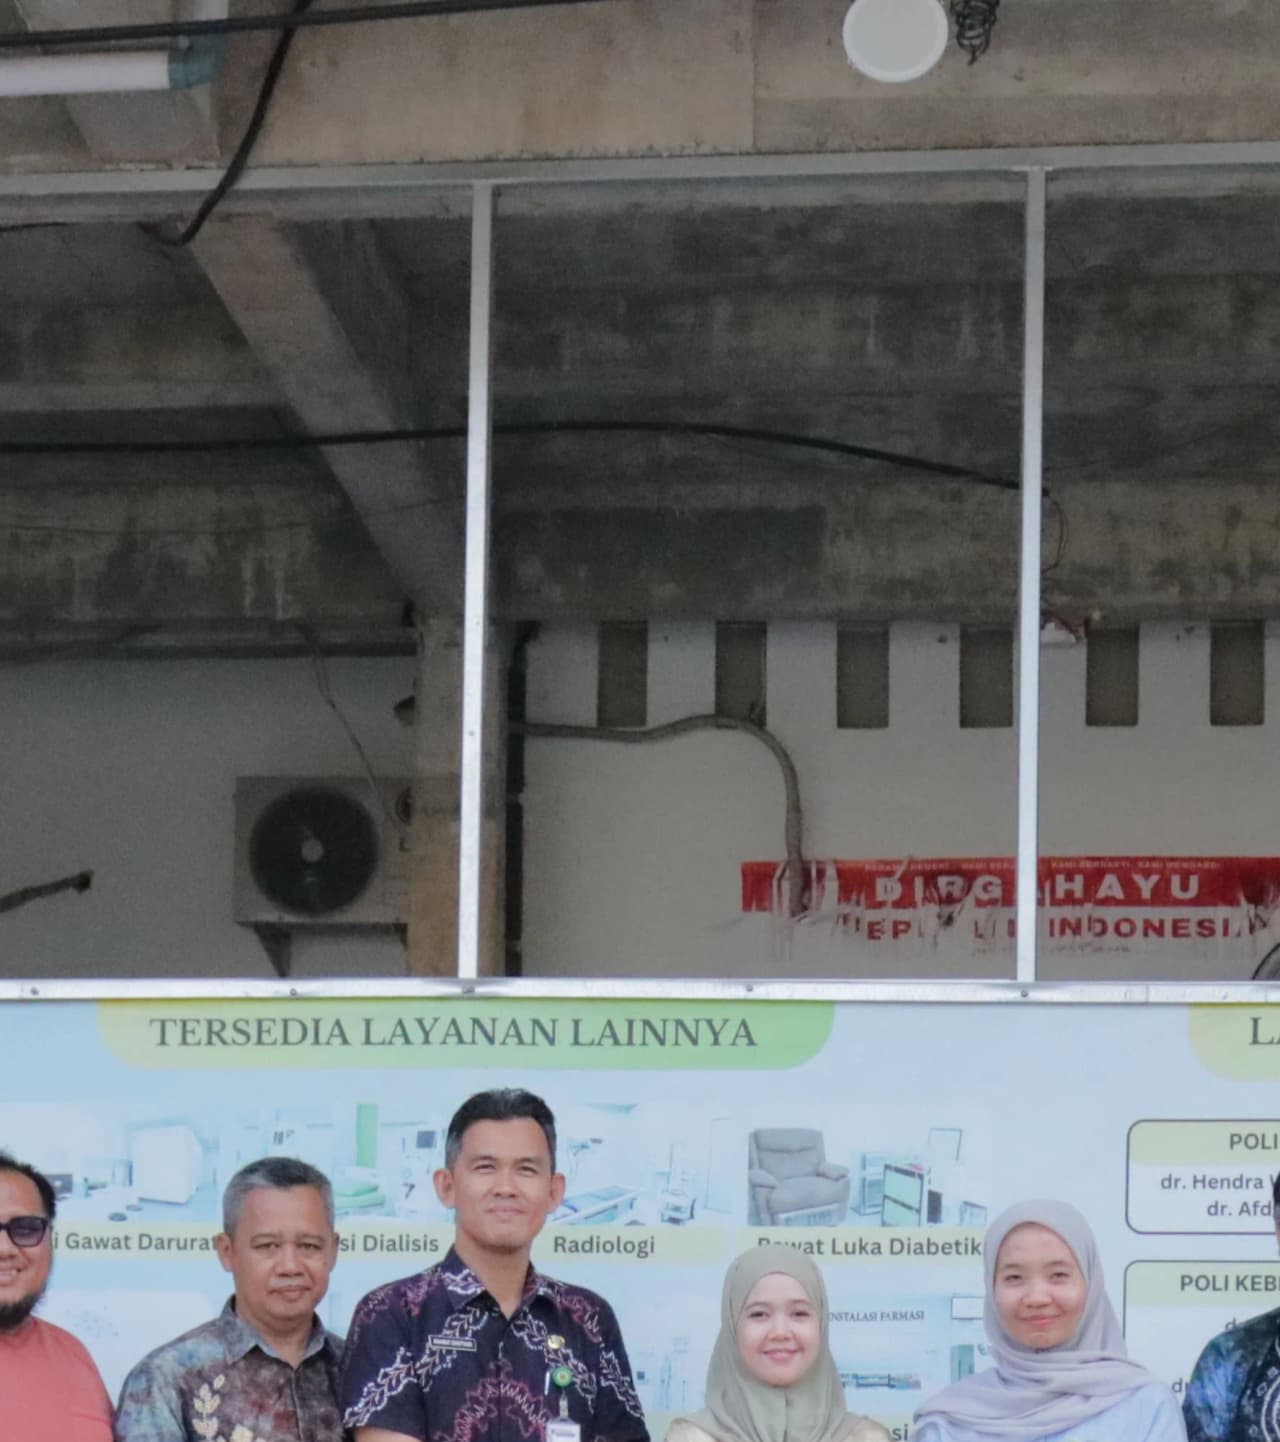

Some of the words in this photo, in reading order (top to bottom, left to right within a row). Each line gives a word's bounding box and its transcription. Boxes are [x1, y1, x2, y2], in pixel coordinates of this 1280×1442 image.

[874, 872, 1200, 901] DIRGHAYU
[150, 1017, 350, 1047] TERSEDIA
[362, 1017, 558, 1047] LAYANAN
[570, 1017, 758, 1047] LAINNYA
[1229, 1133, 1278, 1150] POLI
[1160, 1174, 1187, 1190] dr.
[1193, 1174, 1264, 1191] Hendra
[1207, 1203, 1233, 1218] dr.
[65, 1233, 132, 1250] Gawat
[363, 1234, 440, 1252] Dialisis
[553, 1235, 655, 1259] Radiologi
[832, 1237, 882, 1256] Luka
[889, 1237, 982, 1257] Diabetik
[1180, 1274, 1229, 1292] POLI
[829, 1311, 878, 1321] NSTALASI
